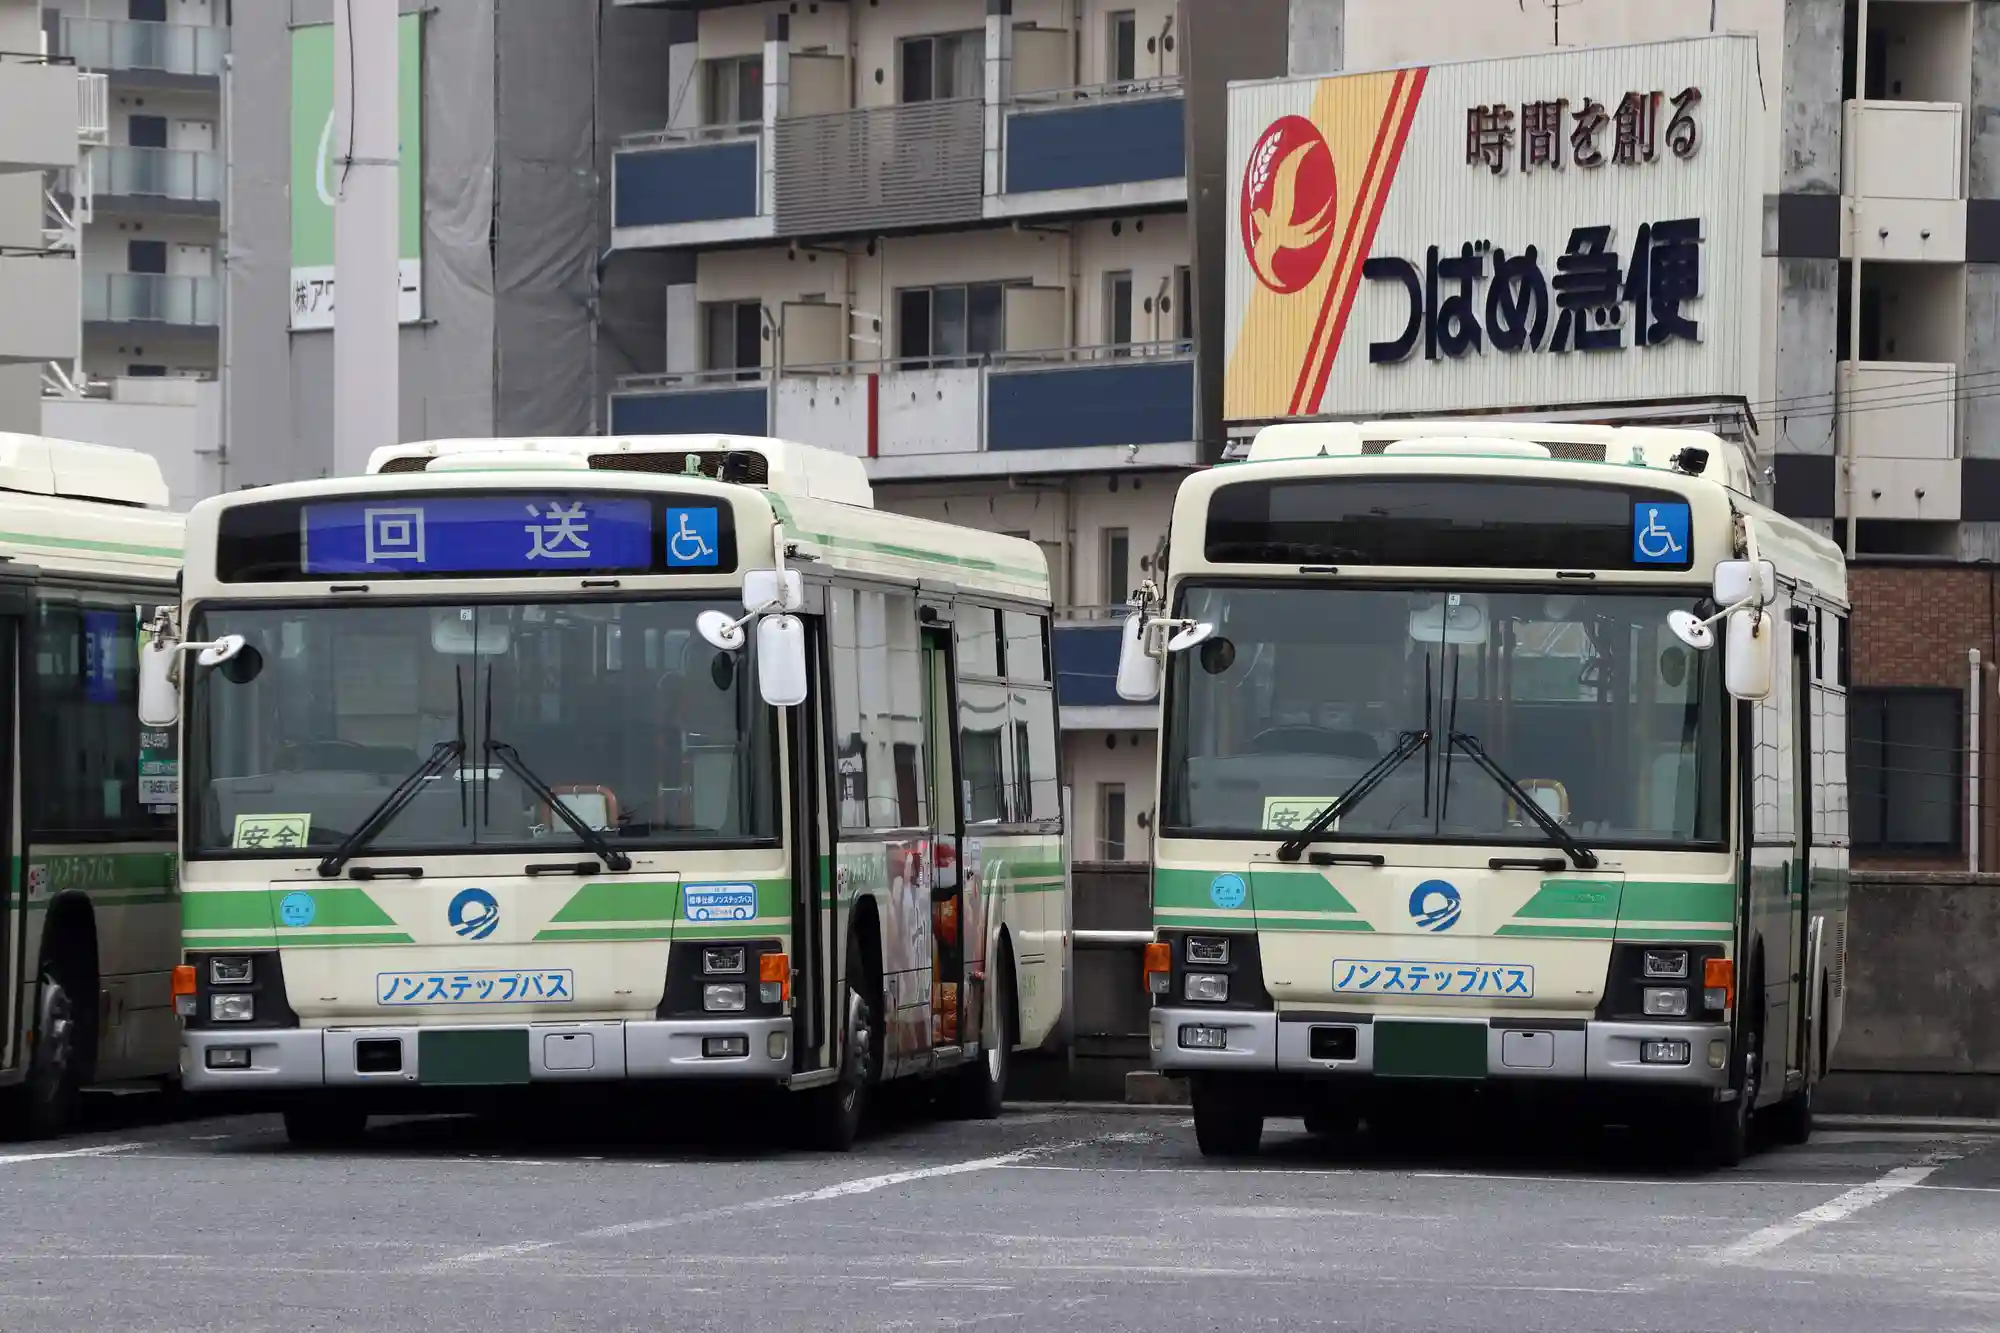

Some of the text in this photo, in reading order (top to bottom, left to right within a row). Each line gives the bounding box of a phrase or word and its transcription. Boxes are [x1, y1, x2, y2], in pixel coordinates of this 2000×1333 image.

[1466, 87, 1702, 175] 時間を創る
[1362, 217, 1705, 364] つばめ急便
[364, 501, 591, 564] 回送
[383, 973, 568, 1001] ノンステップバス
[1338, 965, 1528, 993] ノンステップバス
